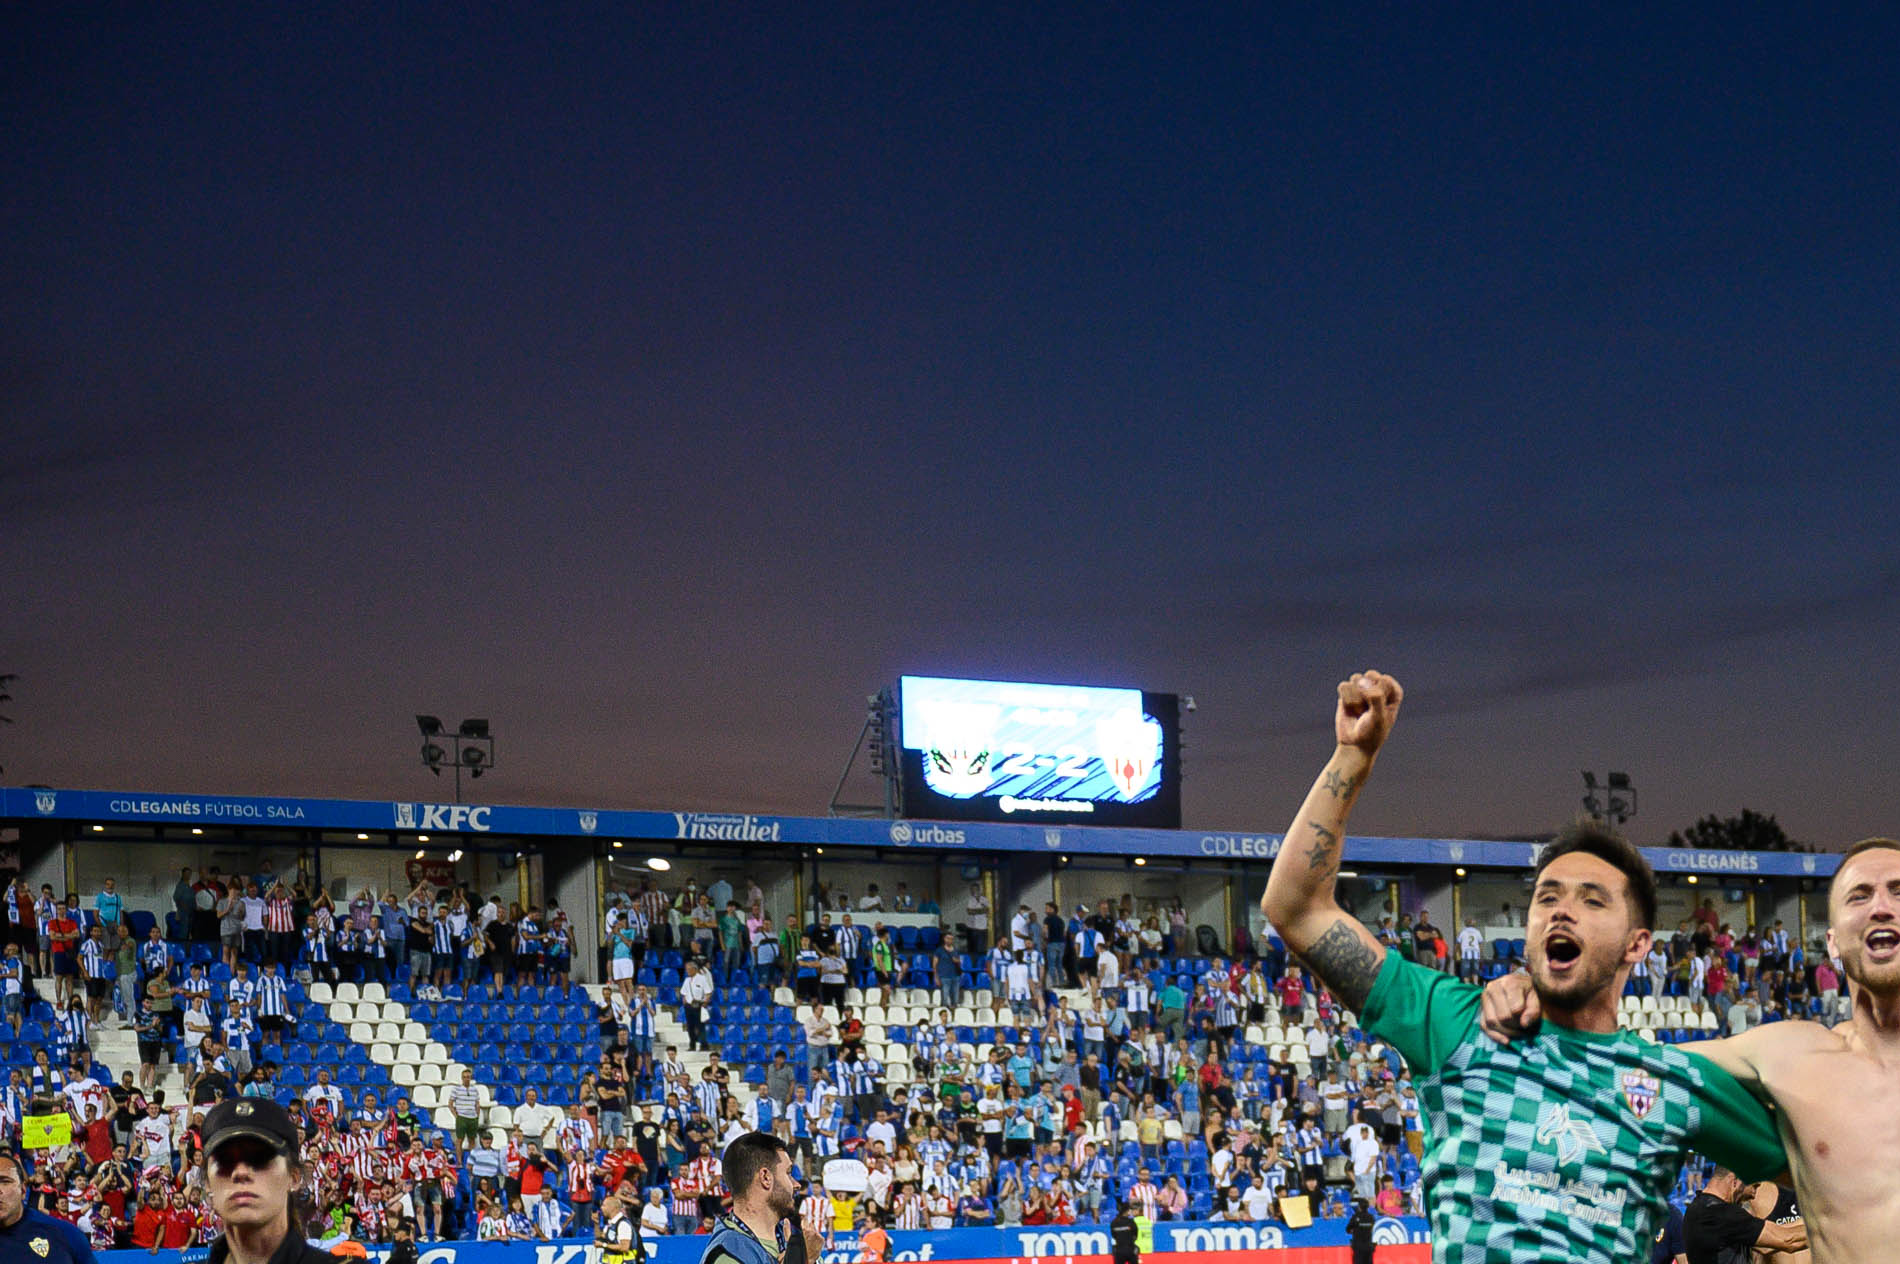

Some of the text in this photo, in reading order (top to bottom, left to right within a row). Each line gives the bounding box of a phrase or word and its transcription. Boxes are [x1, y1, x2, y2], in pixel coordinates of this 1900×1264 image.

[205, 802, 262, 818] FÚTBOL
[267, 806, 304, 819] SALA
[420, 804, 491, 832] KFC
[915, 824, 966, 844] urbas
[1201, 836, 1281, 857] CDLEGA
[1018, 1231, 1116, 1258] Jom
